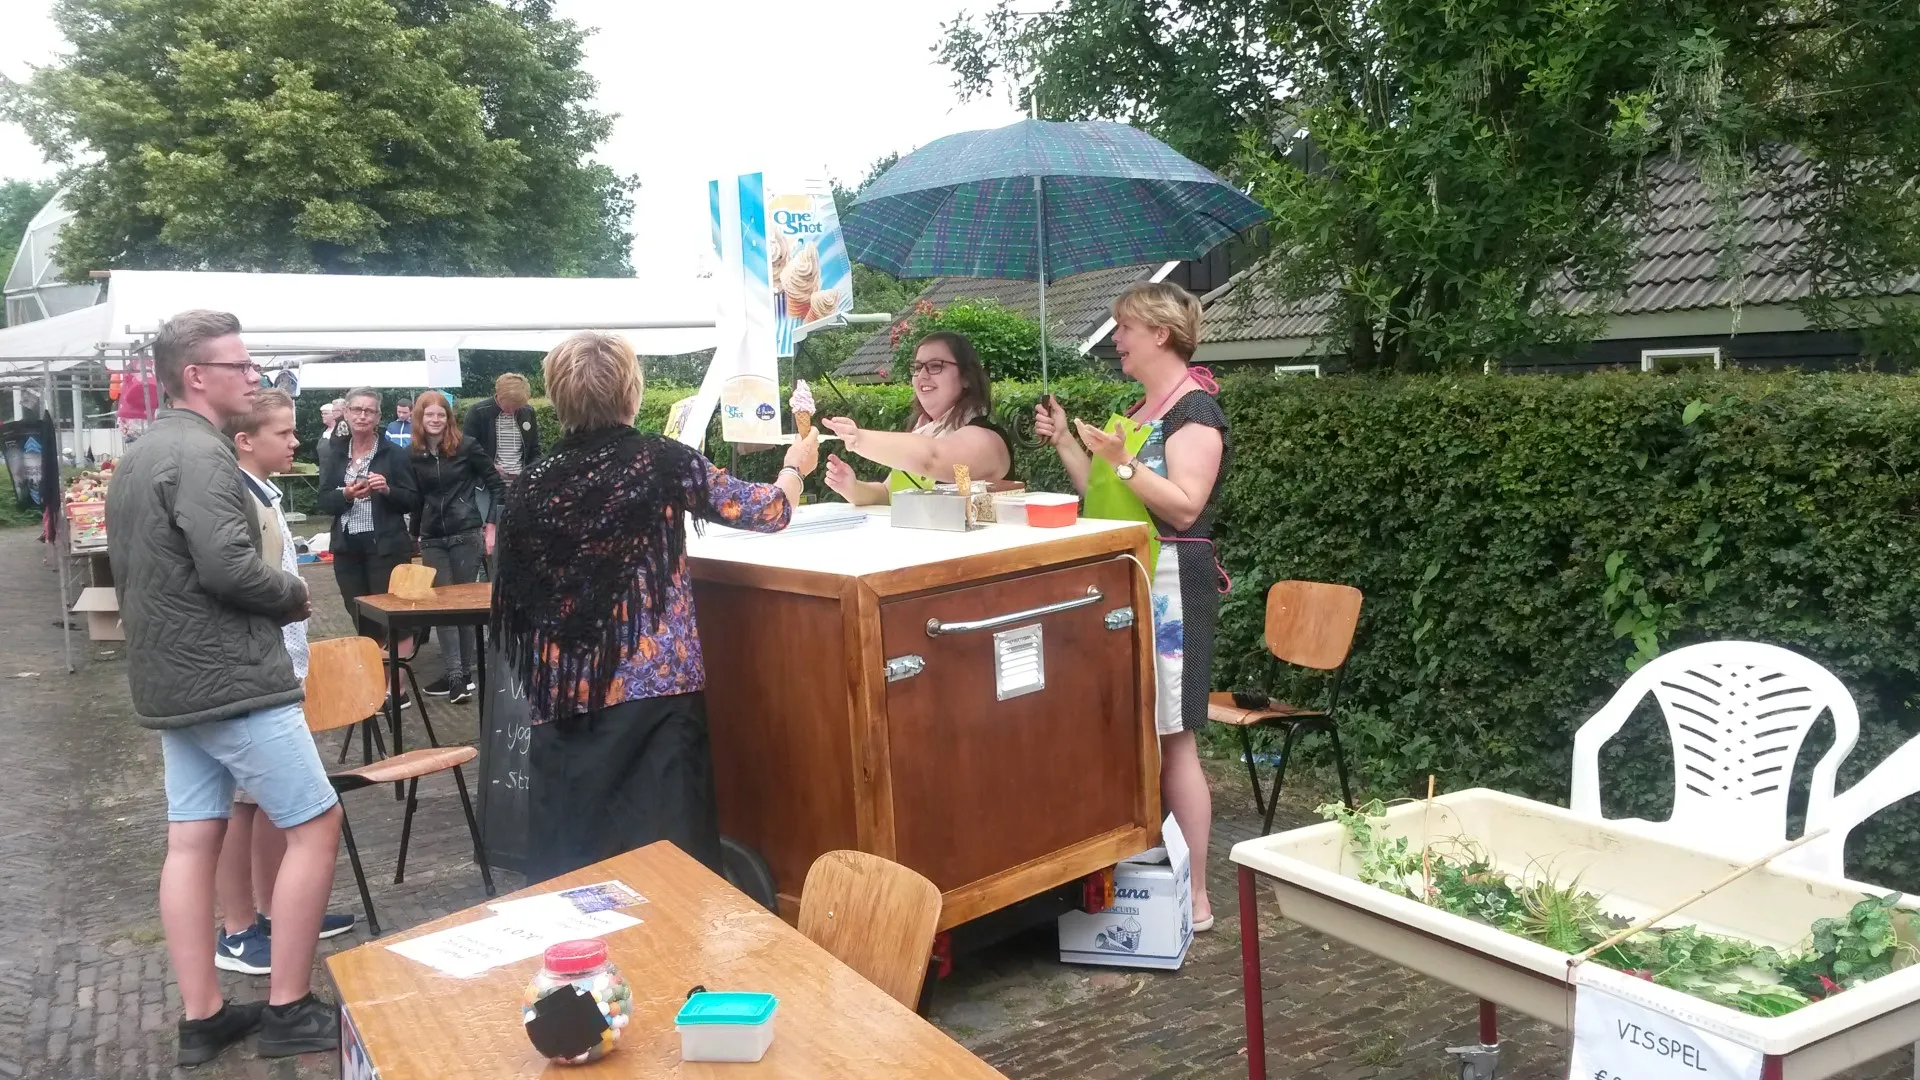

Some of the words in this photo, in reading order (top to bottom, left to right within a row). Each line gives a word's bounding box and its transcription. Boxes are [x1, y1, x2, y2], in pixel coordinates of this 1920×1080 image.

[773, 210, 812, 225] One
[783, 222, 823, 235] Shot
[724, 404, 739, 412] One
[1617, 1018, 1708, 1072] VISSPEL
